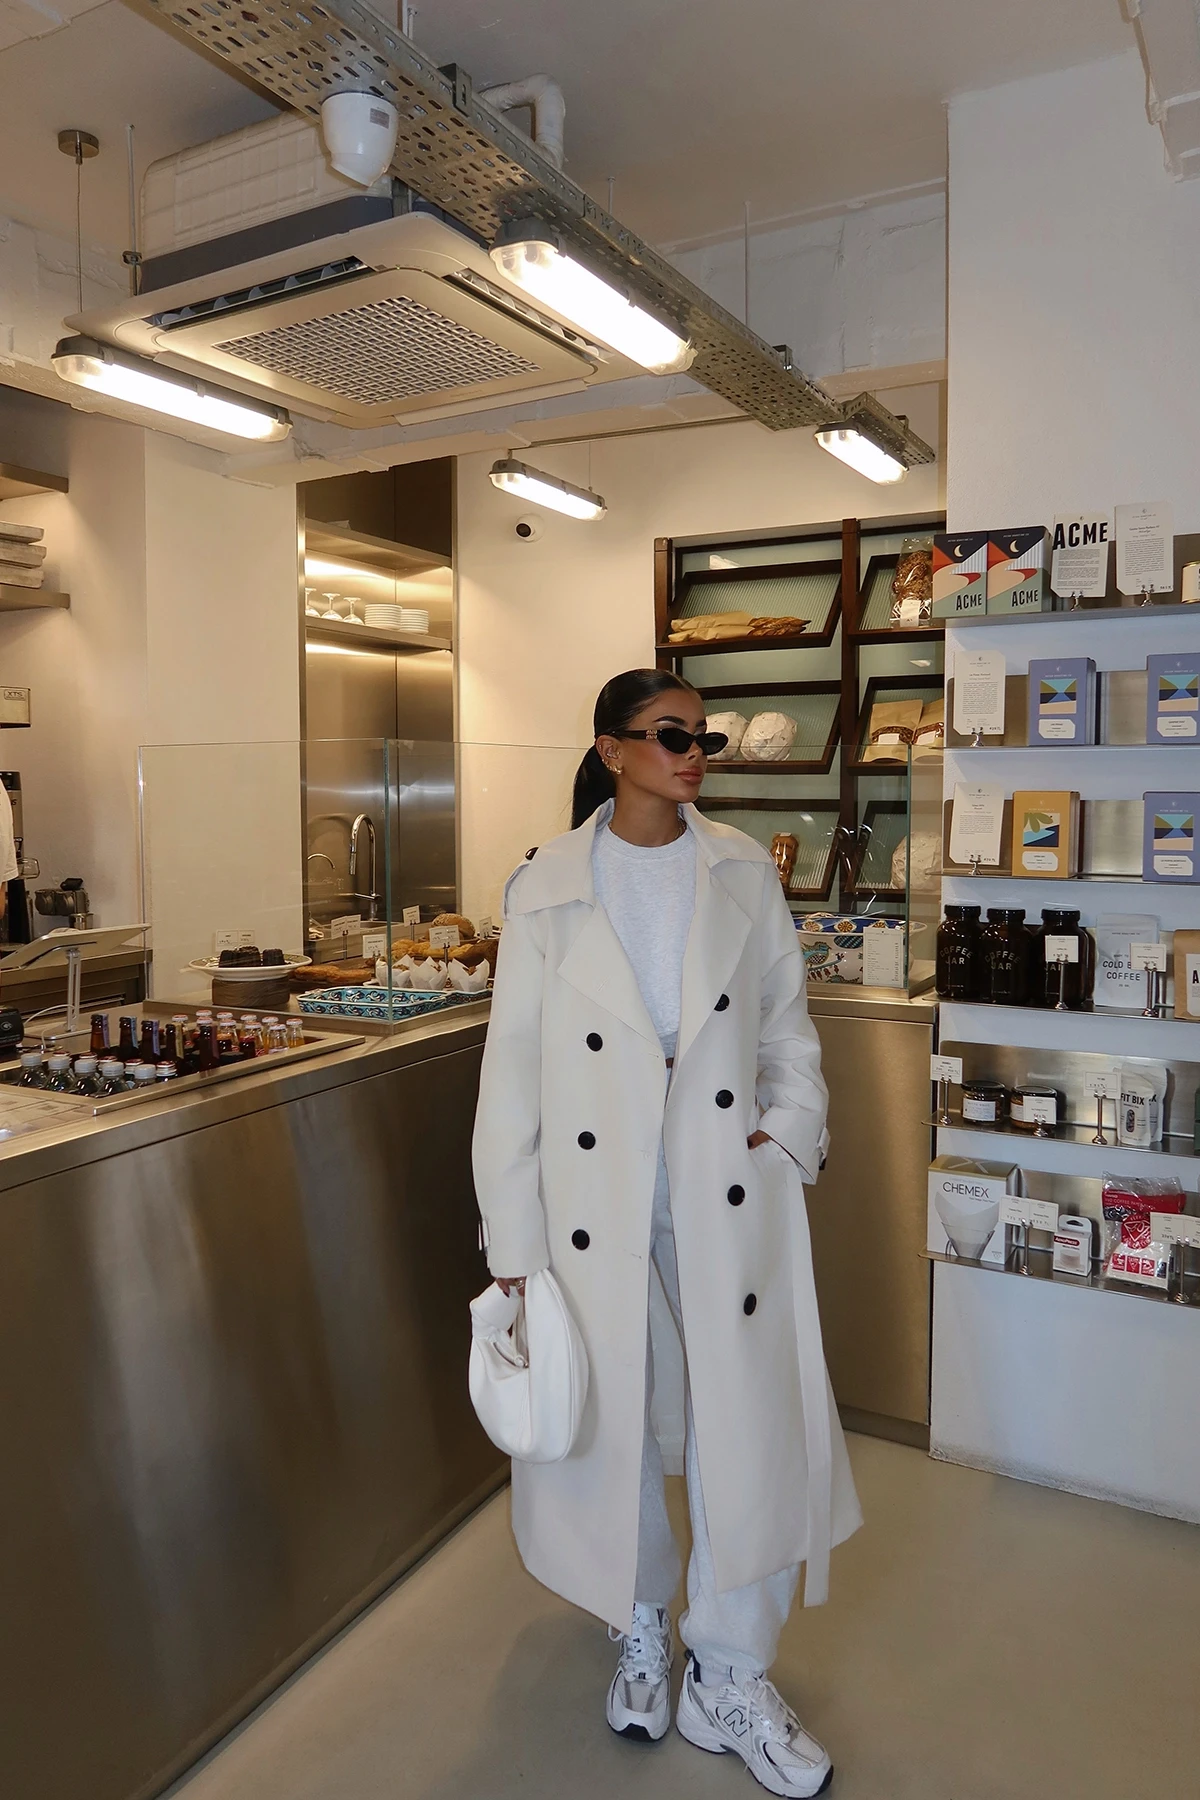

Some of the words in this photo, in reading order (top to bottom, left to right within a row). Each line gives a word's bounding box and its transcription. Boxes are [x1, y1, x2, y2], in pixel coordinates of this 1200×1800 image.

[1052, 522, 1108, 550] ACME
[956, 594, 982, 611] ACME
[1011, 590, 1039, 607] ACME
[940, 946, 973, 958] COFFEE
[984, 950, 1020, 964] COFFEE
[946, 957, 965, 965] JAR
[990, 962, 1012, 970] JAR
[1102, 960, 1123, 969] COLD
[1106, 971, 1140, 980] COFFEE
[1120, 1092, 1131, 1102] FIT
[1131, 1095, 1145, 1106] BIX
[942, 1182, 989, 1198] CHEMEX
